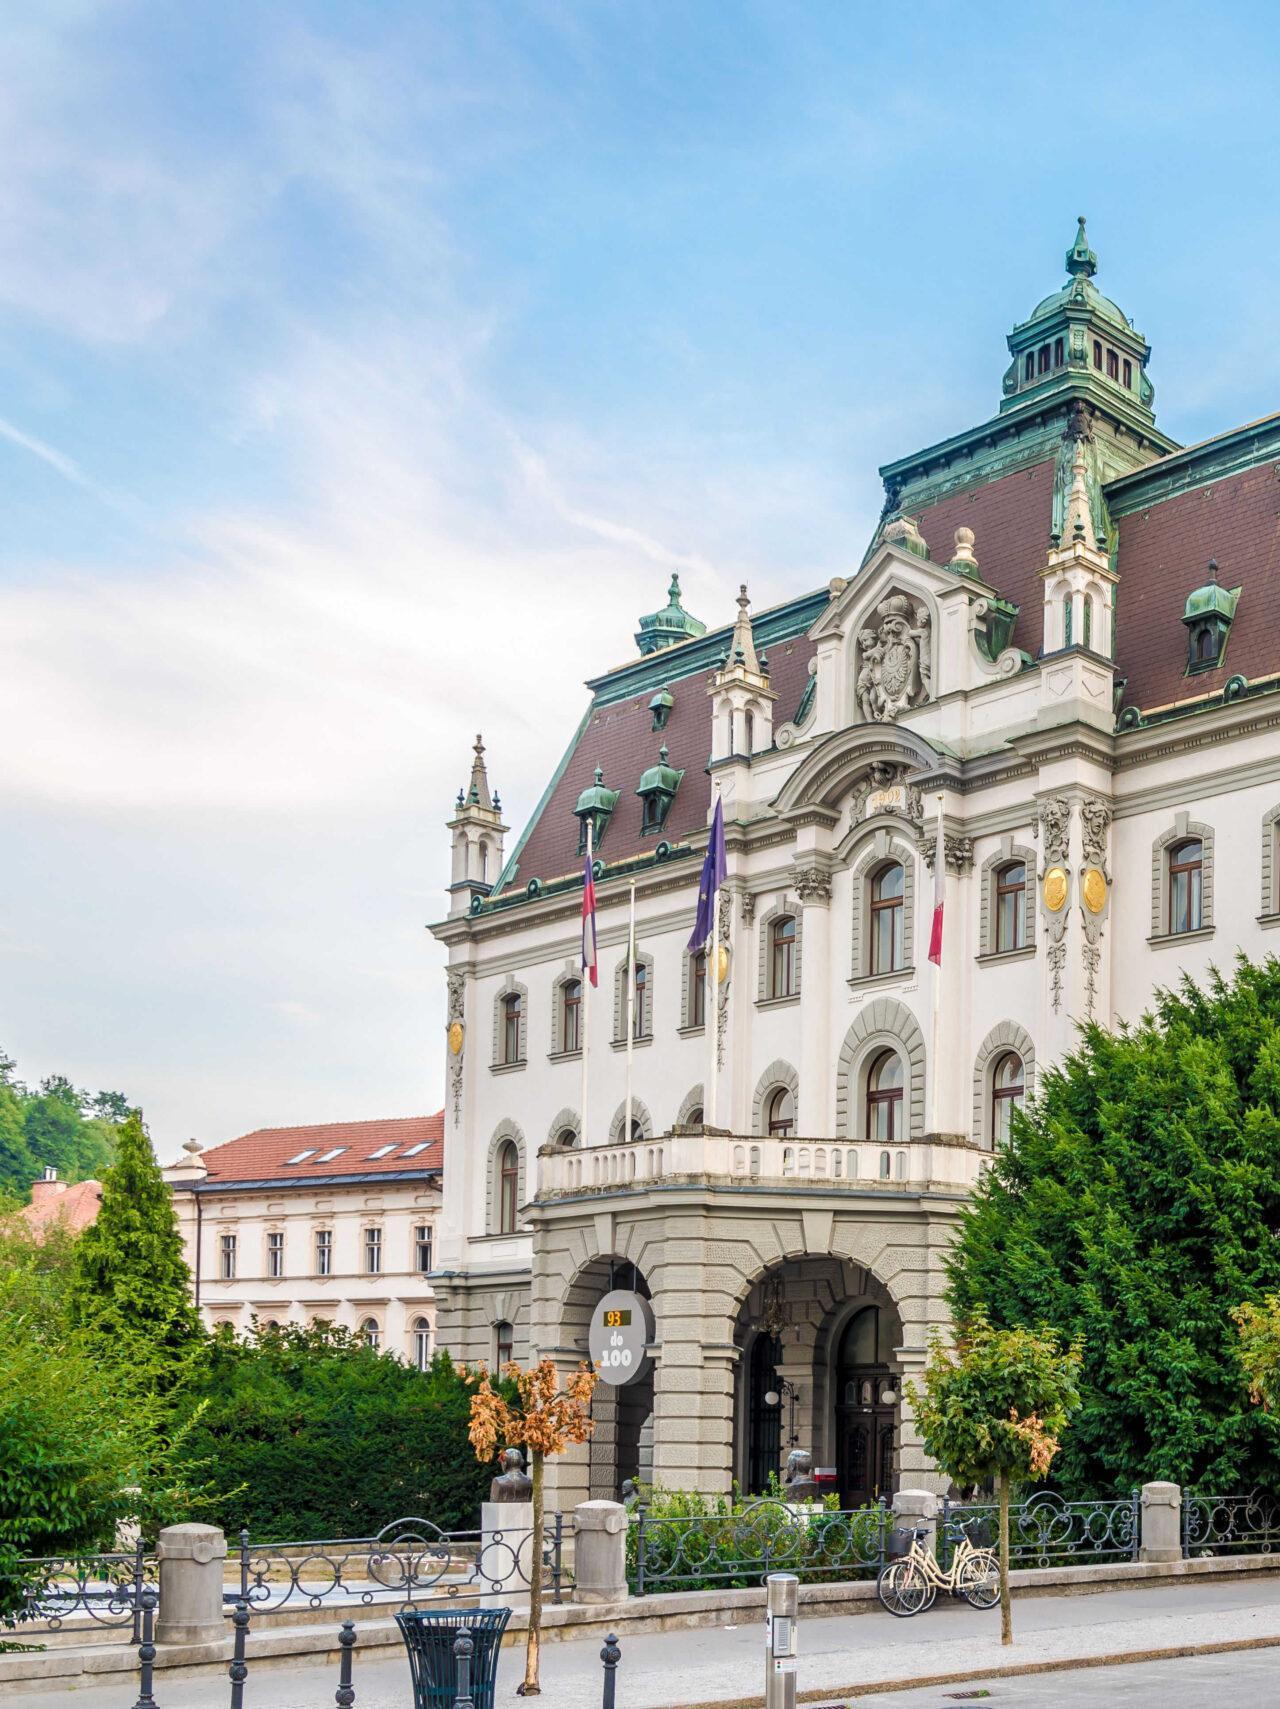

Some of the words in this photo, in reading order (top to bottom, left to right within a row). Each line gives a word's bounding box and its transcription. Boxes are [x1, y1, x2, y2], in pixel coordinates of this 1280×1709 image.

[607, 1311, 621, 1327] 93
[610, 1330, 624, 1346] do
[601, 1349, 632, 1367] 100
